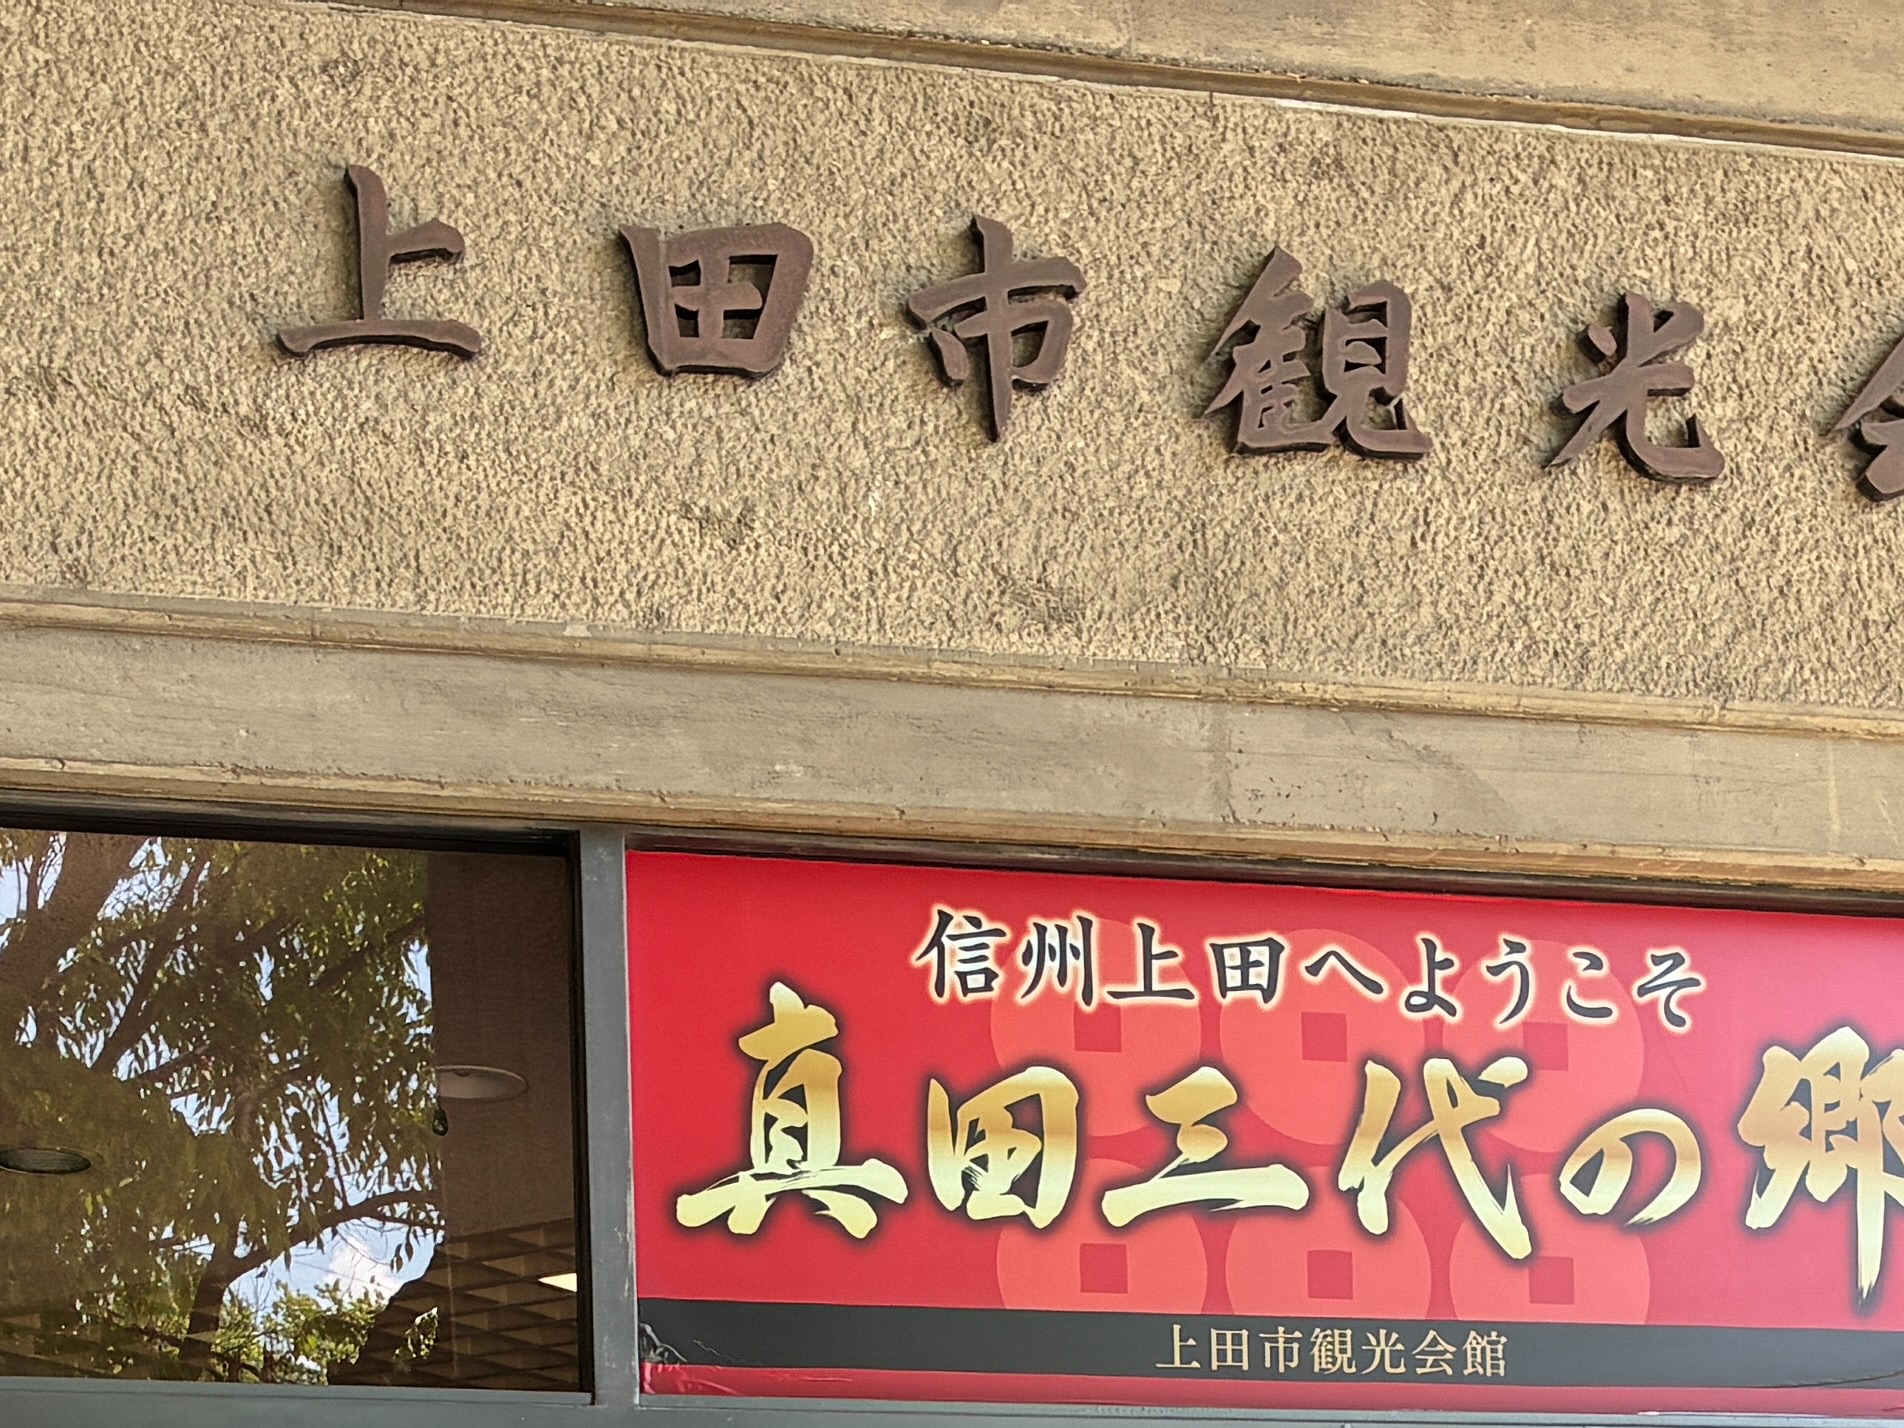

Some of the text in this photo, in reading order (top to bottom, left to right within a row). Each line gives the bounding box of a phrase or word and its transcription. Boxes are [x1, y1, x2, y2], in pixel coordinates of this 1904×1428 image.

[914, 907, 1706, 1032] 信州上田へようこそ
[1155, 1324, 1509, 1378] 上田市観光会館
